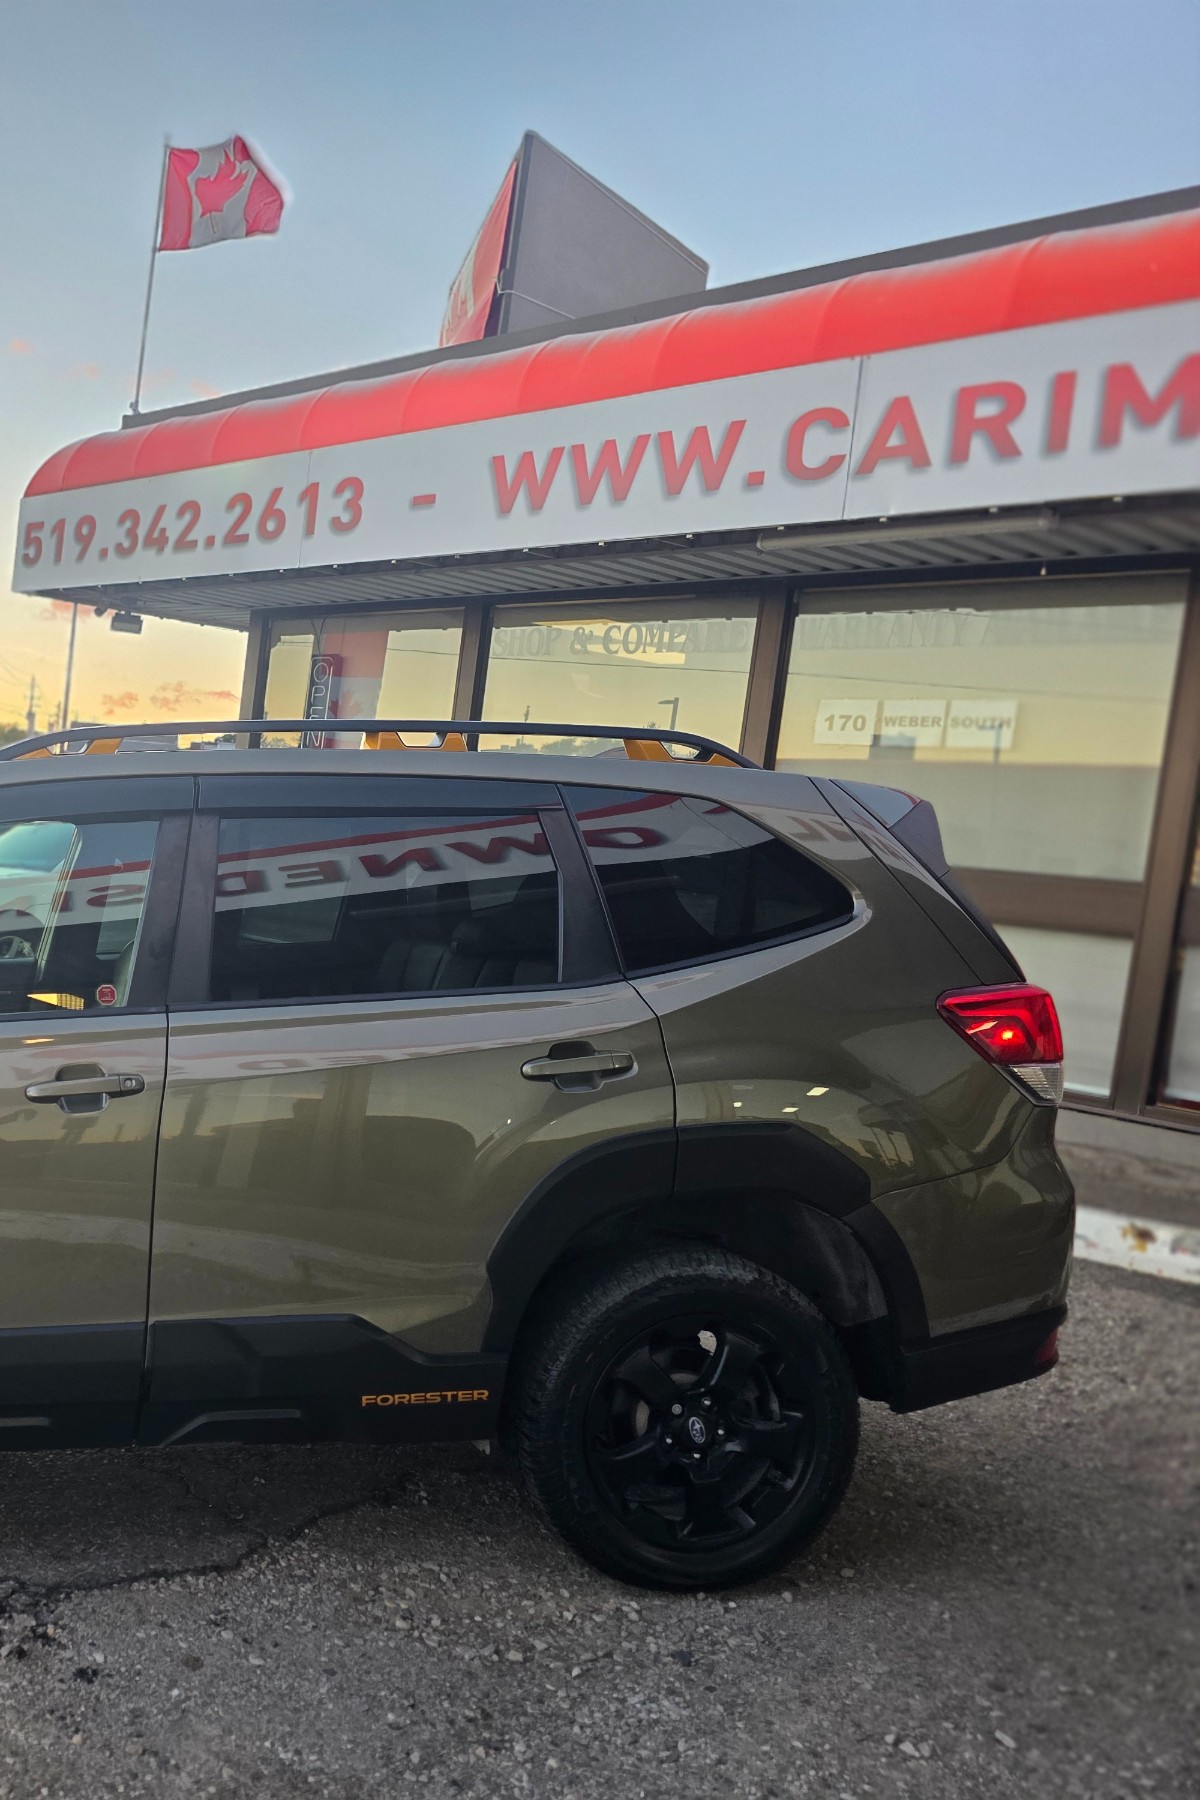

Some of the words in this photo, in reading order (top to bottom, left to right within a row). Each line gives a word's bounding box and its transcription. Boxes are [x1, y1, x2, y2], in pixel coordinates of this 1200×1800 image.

[22, 476, 365, 567] 519.342.2613
[492, 352, 1200, 516] WWW.CARIM
[493, 627, 561, 656] SHOP
[570, 626, 593, 655] &
[603, 619, 749, 655] COMPARE
[824, 714, 867, 732] 170
[884, 716, 942, 728] WEBER
[951, 715, 1013, 729] SOUTH
[361, 1389, 489, 1407] FORESTER
